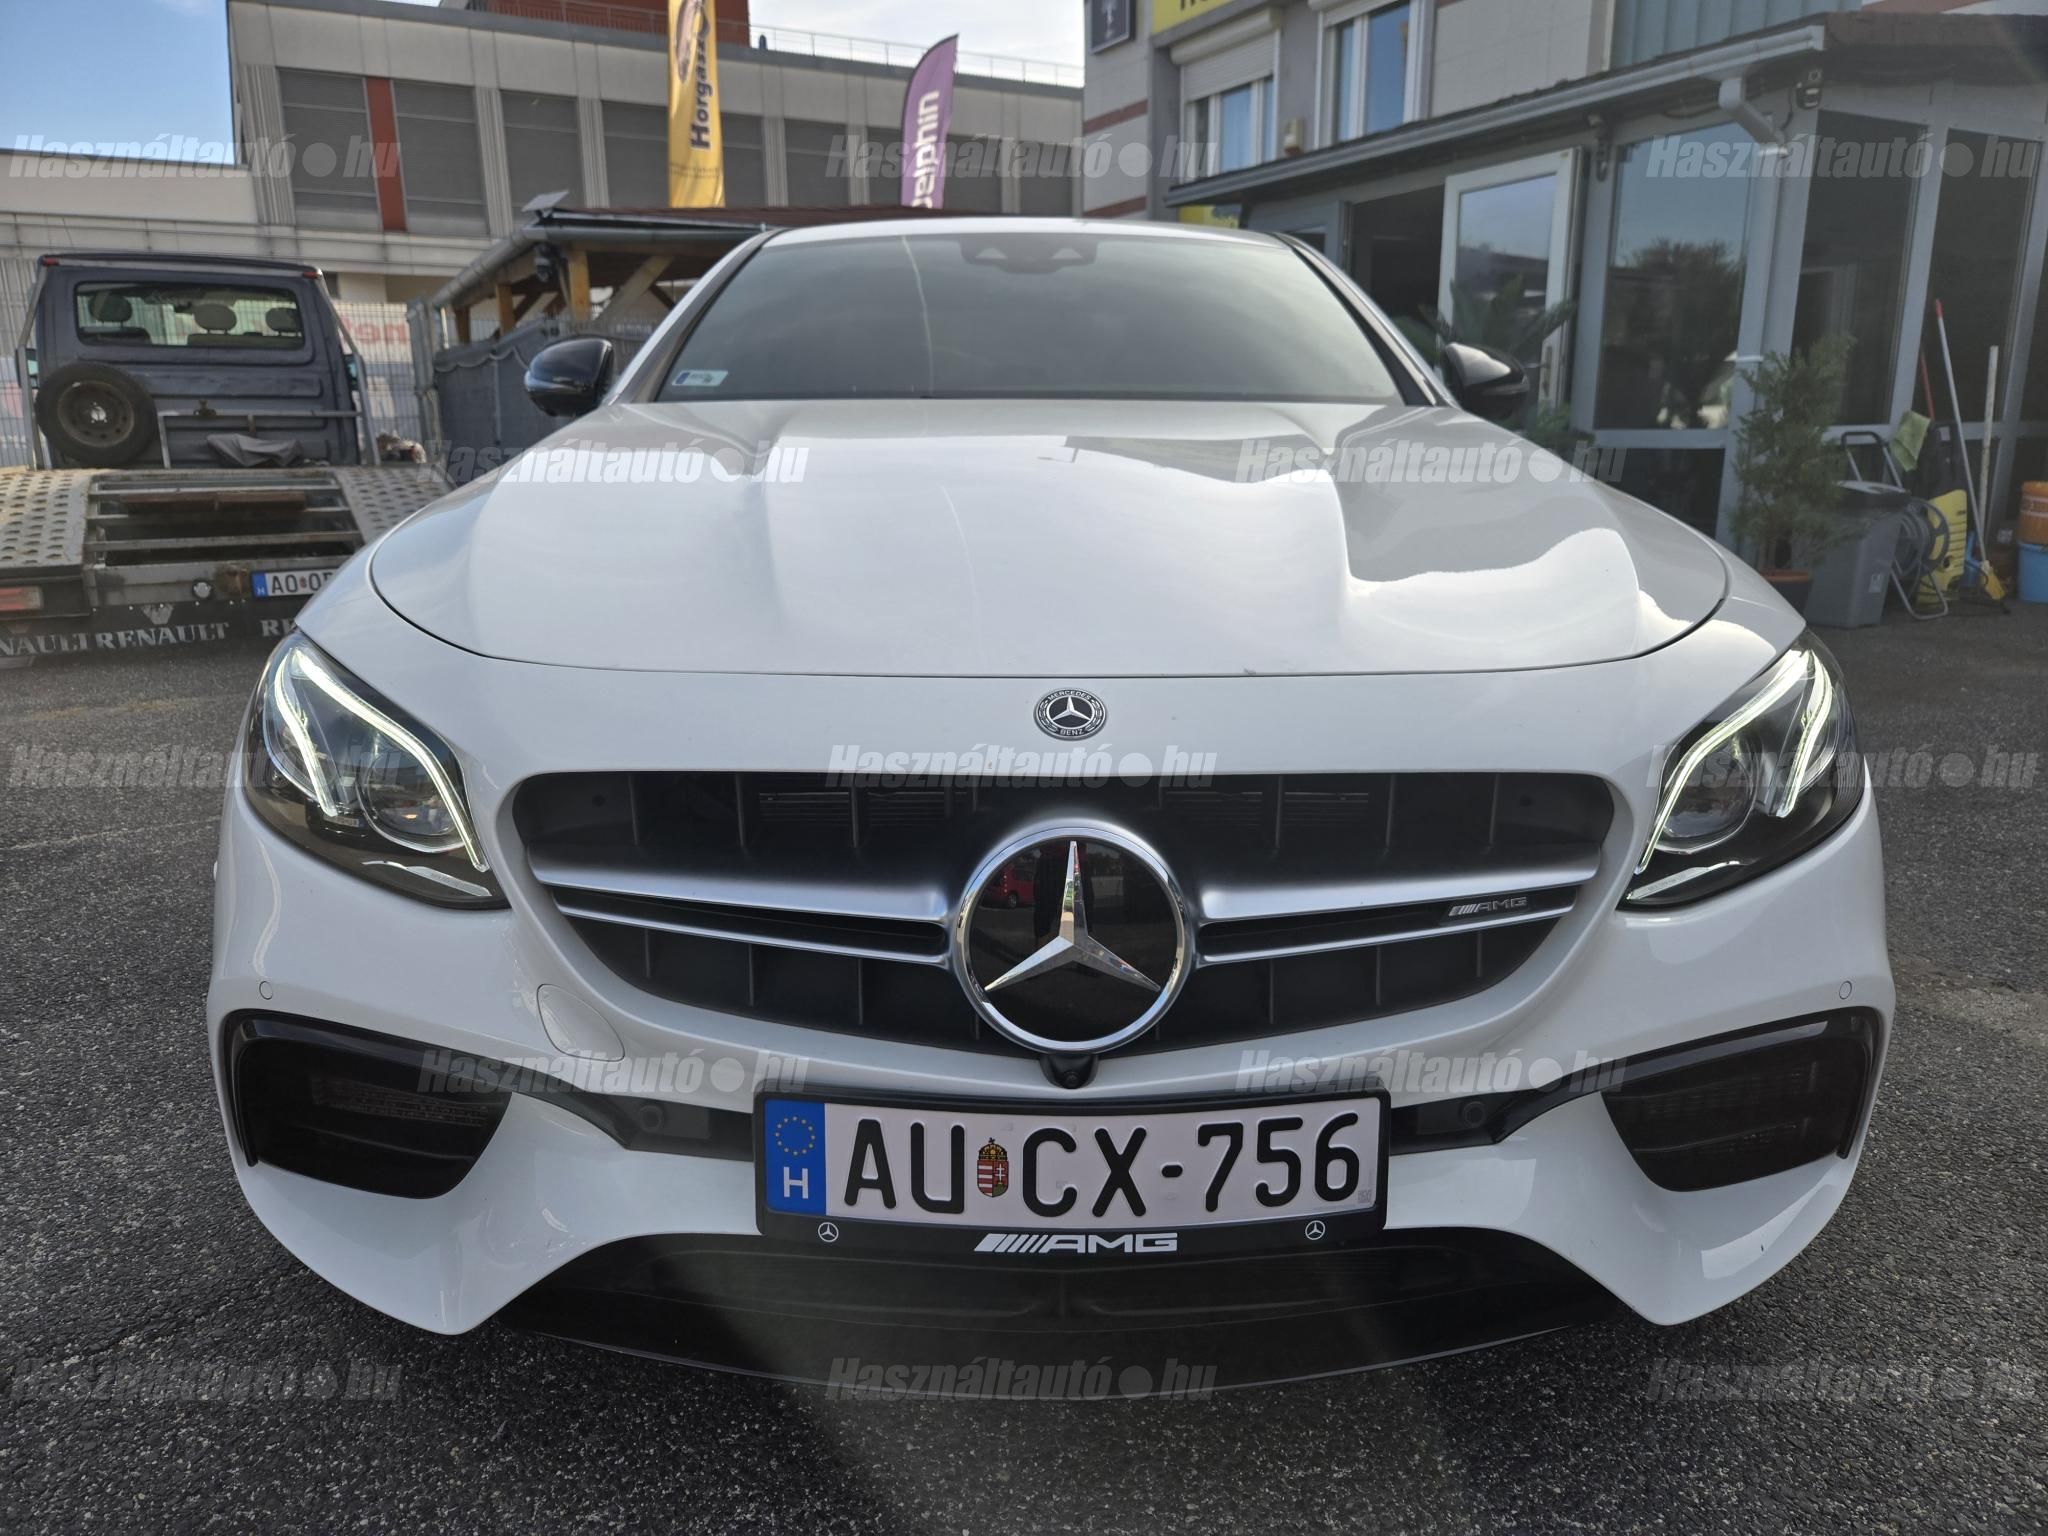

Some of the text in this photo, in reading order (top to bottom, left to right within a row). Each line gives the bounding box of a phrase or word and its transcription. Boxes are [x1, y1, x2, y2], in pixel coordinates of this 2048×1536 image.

[95, 622, 228, 649] RENAULT
[1047, 690, 1092, 701] MERCEDES
[1060, 728, 1085, 736] BENZ
[783, 1166, 809, 1200] H
